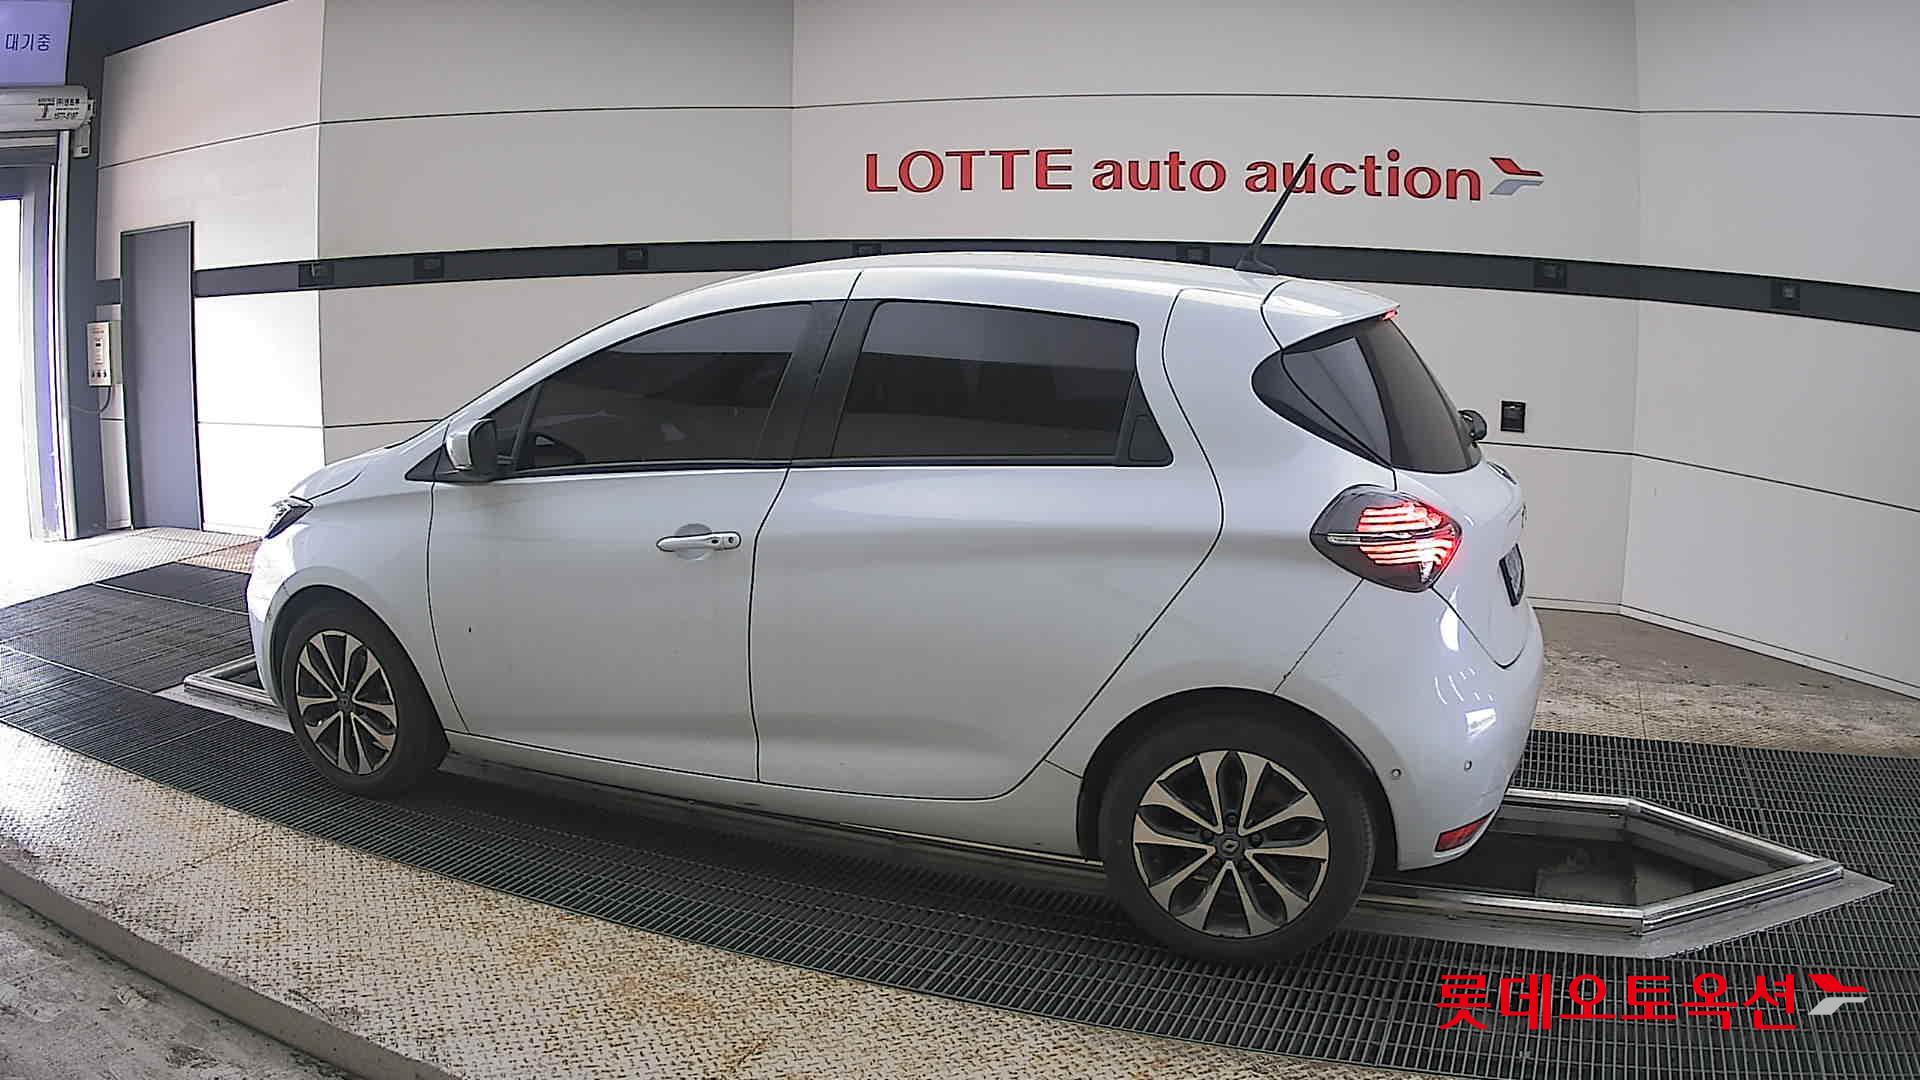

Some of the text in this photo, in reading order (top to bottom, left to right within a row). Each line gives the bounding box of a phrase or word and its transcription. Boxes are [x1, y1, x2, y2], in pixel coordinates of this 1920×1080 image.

[5, 33, 51, 52] 대기중
[866, 148, 1481, 201] LOTTE auto auction
